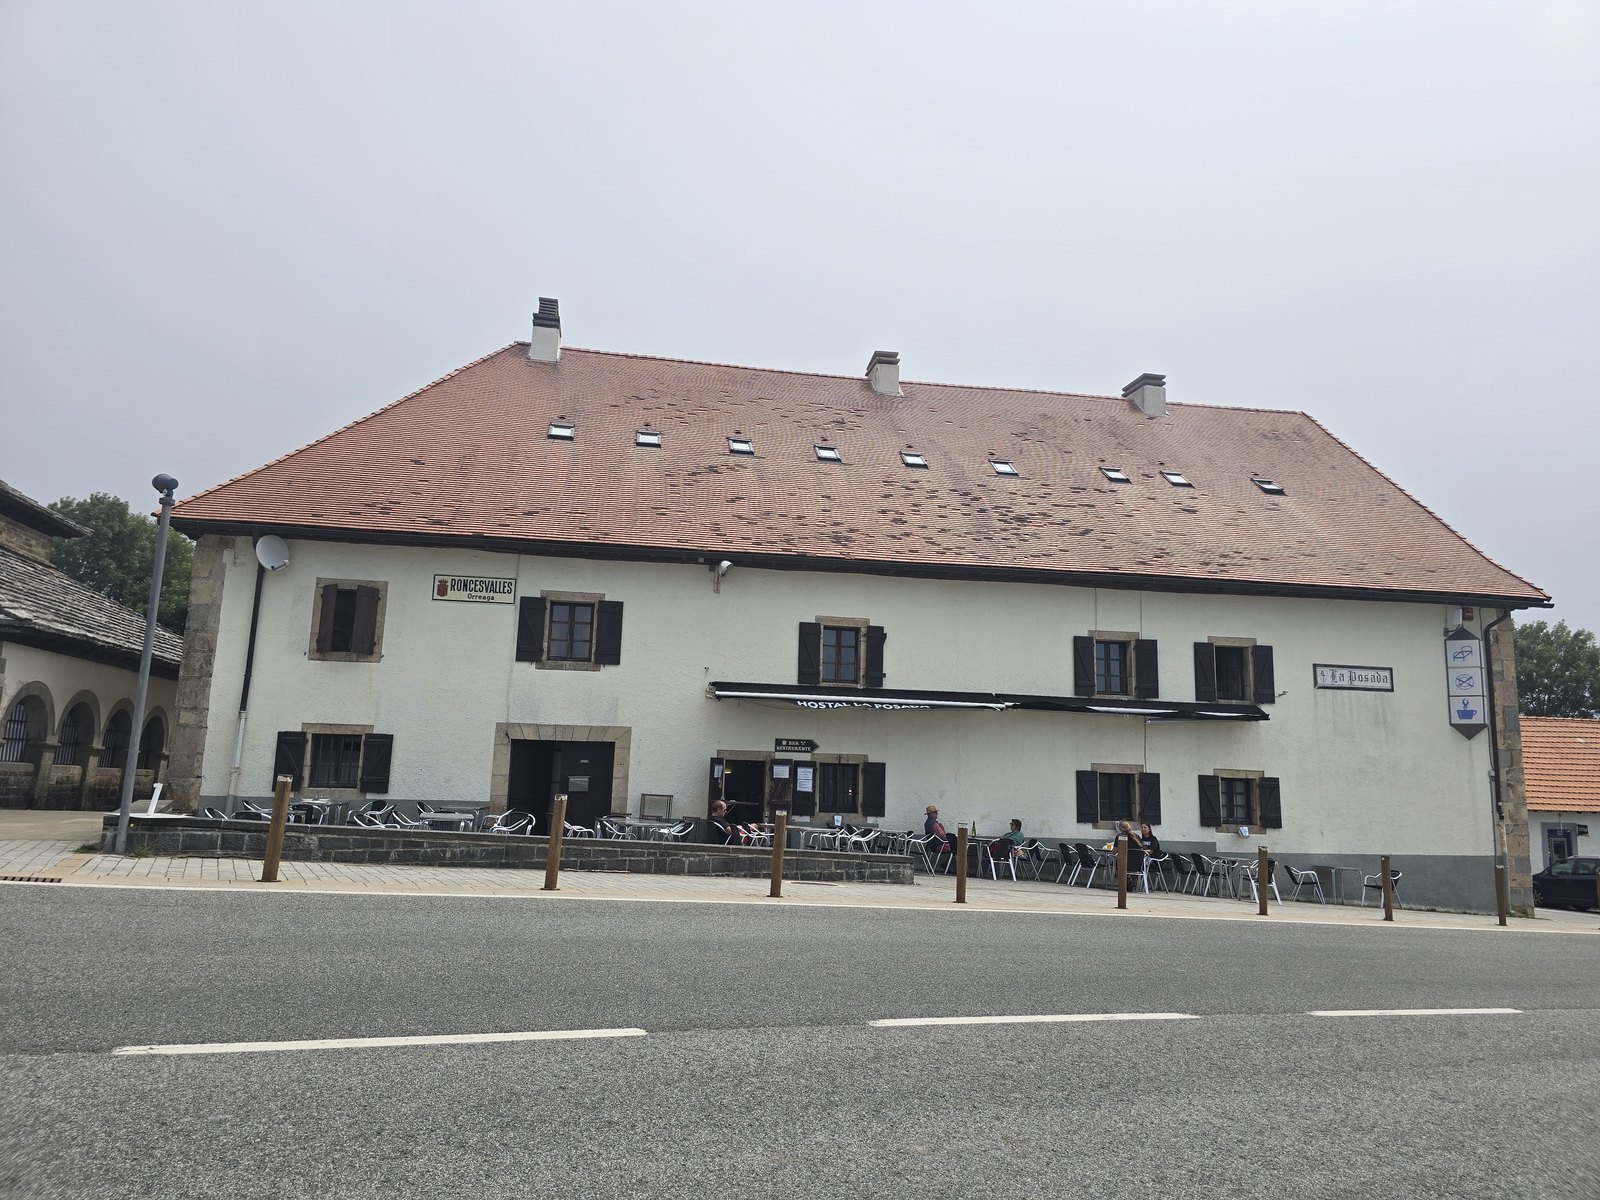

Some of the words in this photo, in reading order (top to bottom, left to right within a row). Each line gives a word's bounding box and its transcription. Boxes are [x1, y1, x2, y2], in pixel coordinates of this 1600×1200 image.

[450, 578, 513, 594] RONCESVALLES
[467, 593, 495, 601] Orreaga
[1329, 669, 1345, 683] La
[1349, 670, 1388, 685] Posada
[797, 700, 851, 709] HOSTAL
